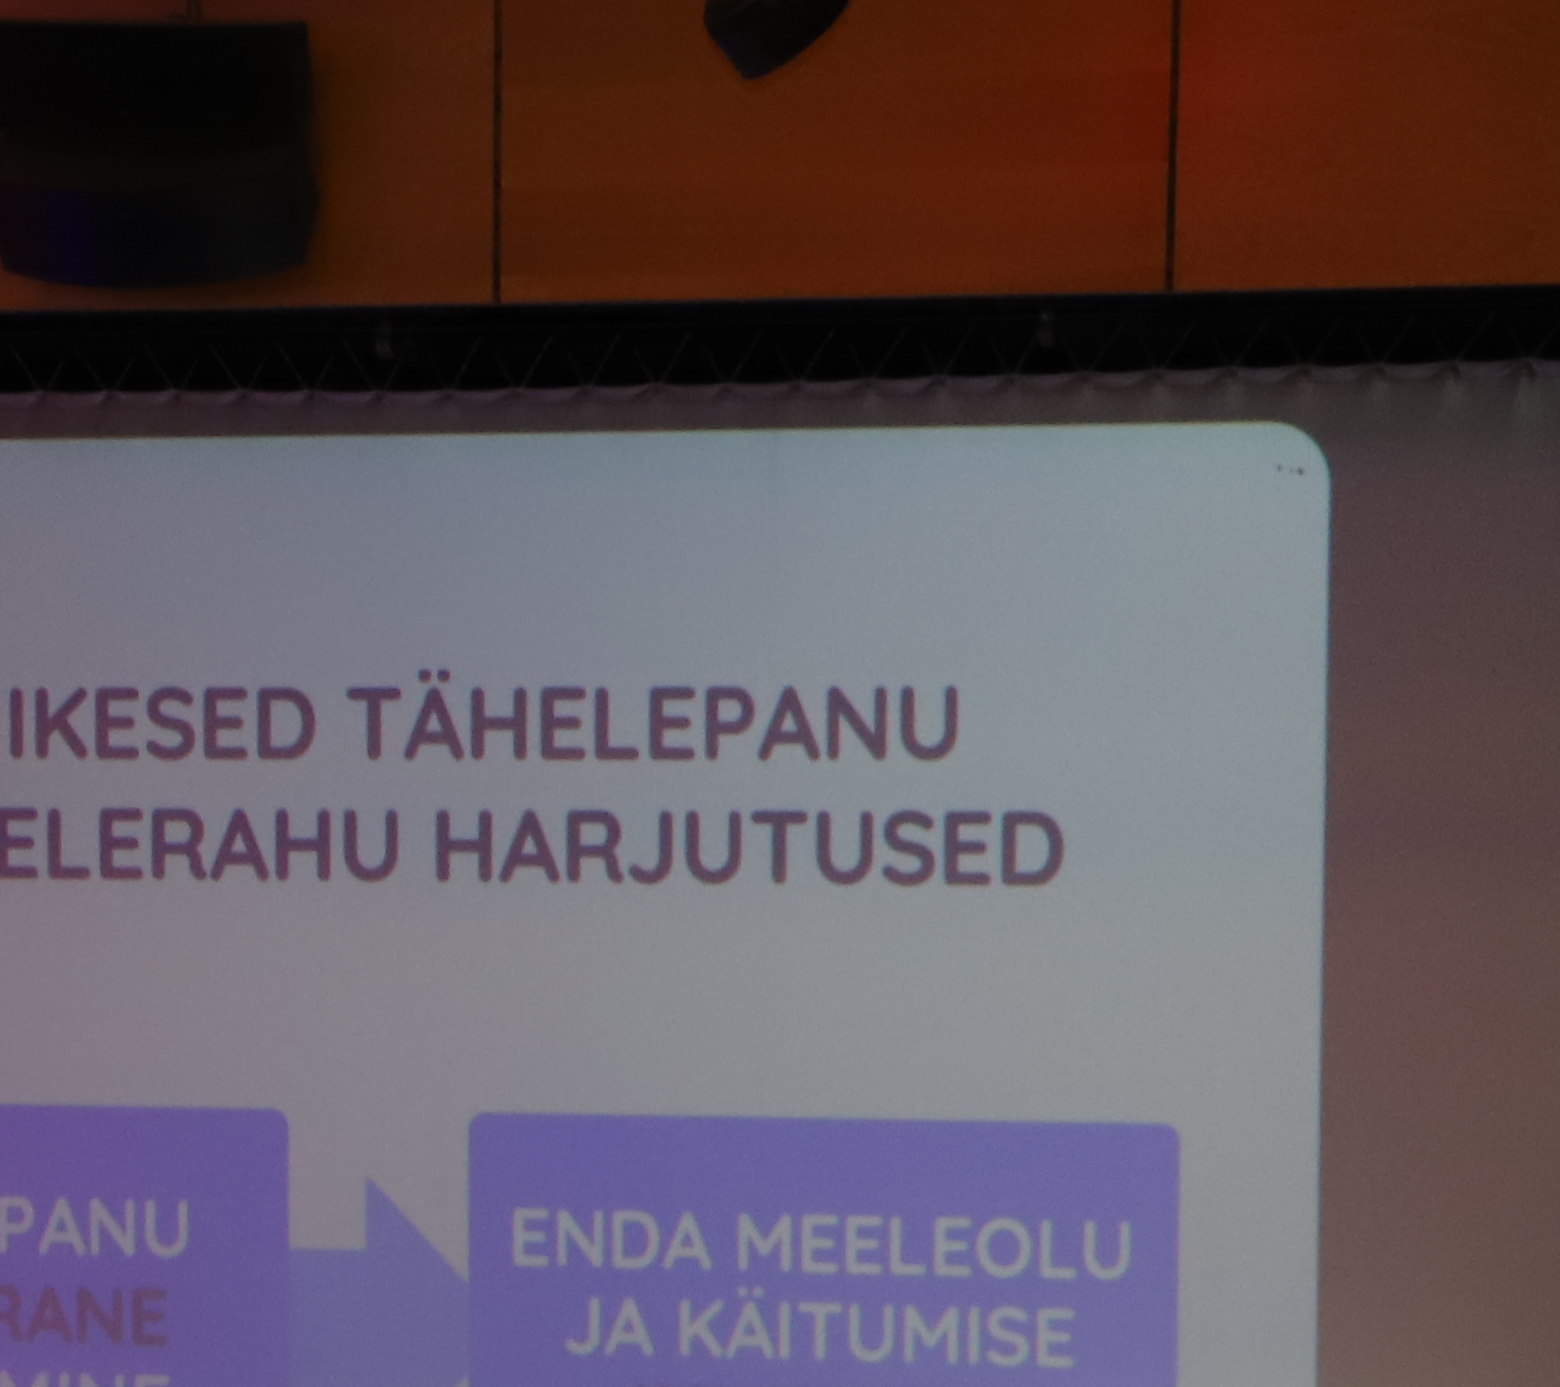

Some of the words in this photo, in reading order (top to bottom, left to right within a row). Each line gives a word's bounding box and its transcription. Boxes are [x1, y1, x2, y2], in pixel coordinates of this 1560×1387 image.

[345, 668, 959, 762] TÄHELEPANU
[434, 808, 1066, 887] HARJUTUSED
[511, 1206, 713, 1272] ENDA
[735, 1212, 1133, 1281] MEELEOLU
[564, 1296, 656, 1359] JA
[678, 1284, 1076, 1369] KÄITUMISE
